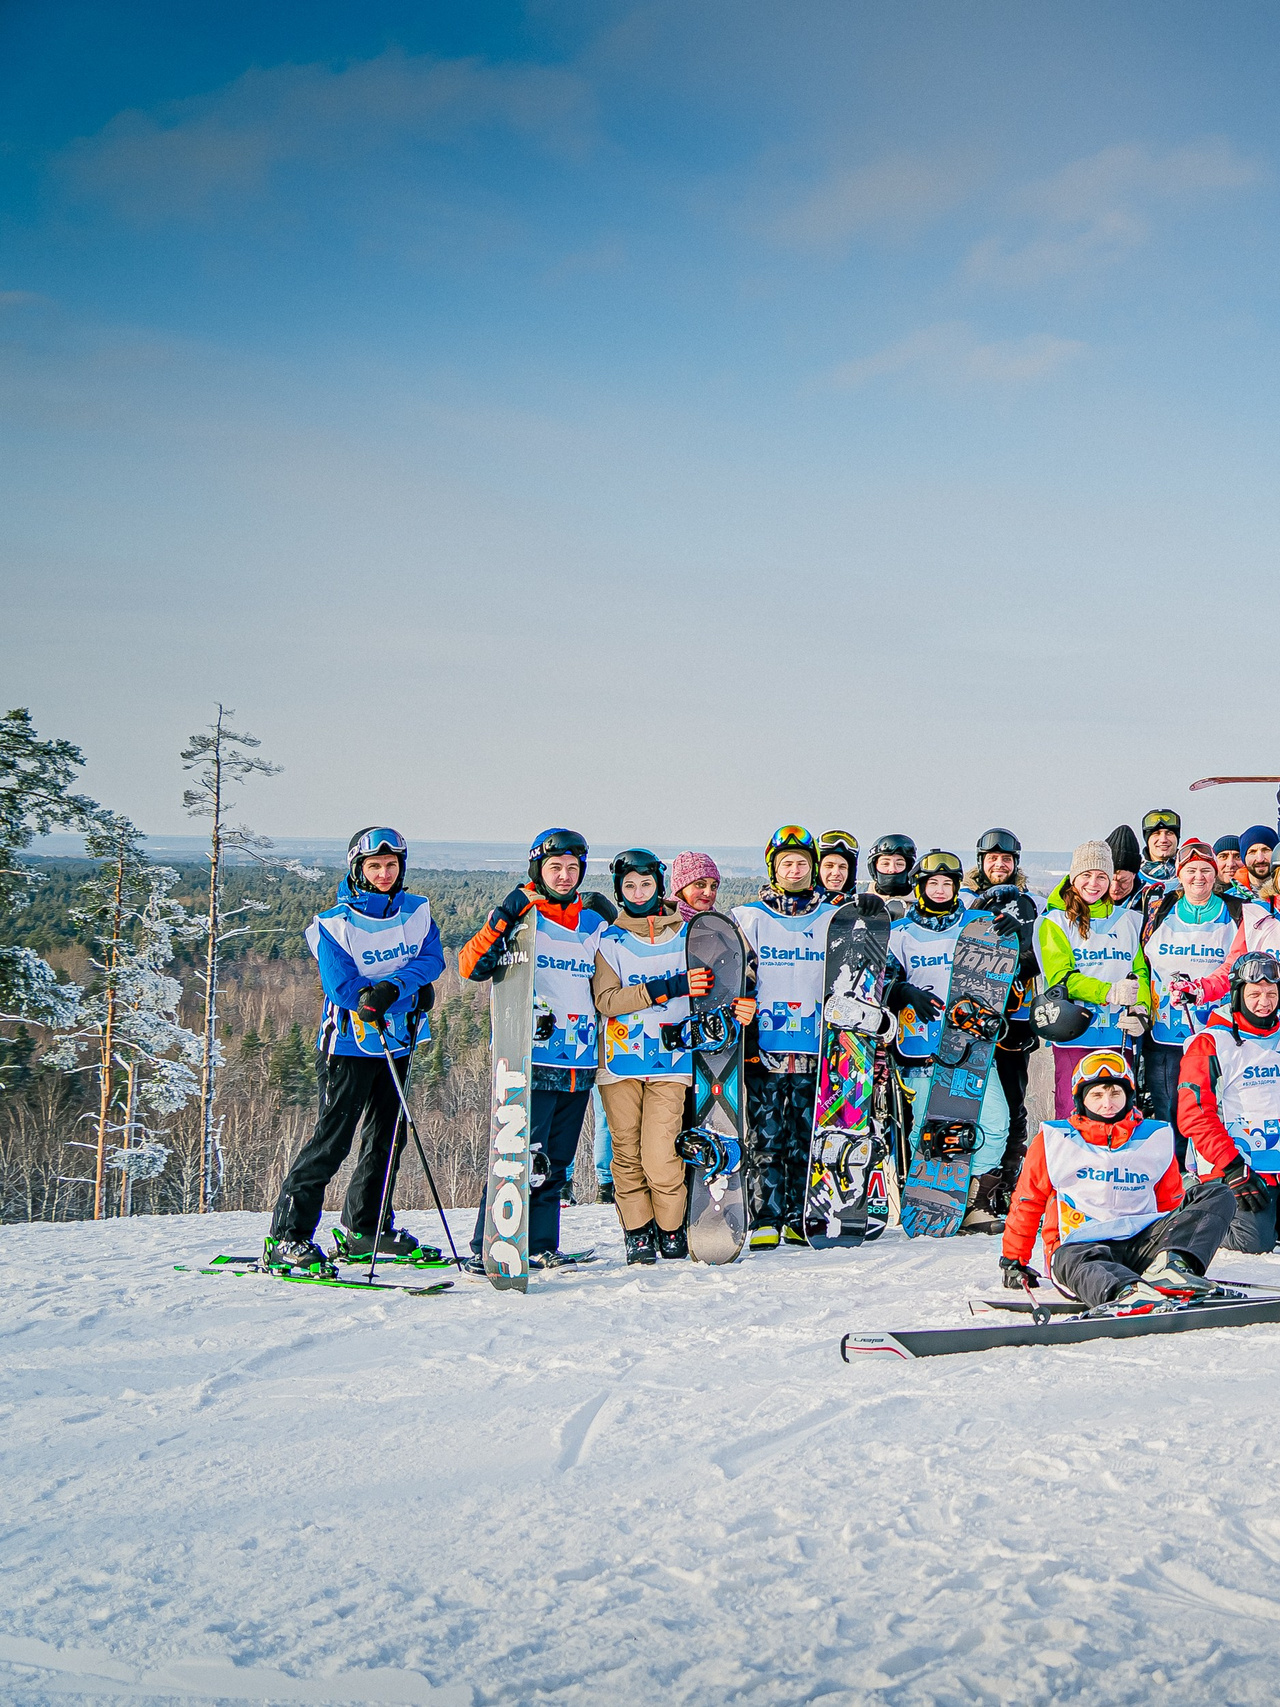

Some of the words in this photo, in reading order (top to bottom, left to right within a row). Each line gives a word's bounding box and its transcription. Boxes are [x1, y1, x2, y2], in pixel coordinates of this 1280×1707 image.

[1072, 947, 1132, 961] StarLine
[1158, 943, 1225, 957] StarLine
[536, 954, 596, 975] StarLine
[910, 953, 953, 969] StarL
[489, 1060, 528, 1278] JOINT
[1076, 1167, 1150, 1184] StarLine
